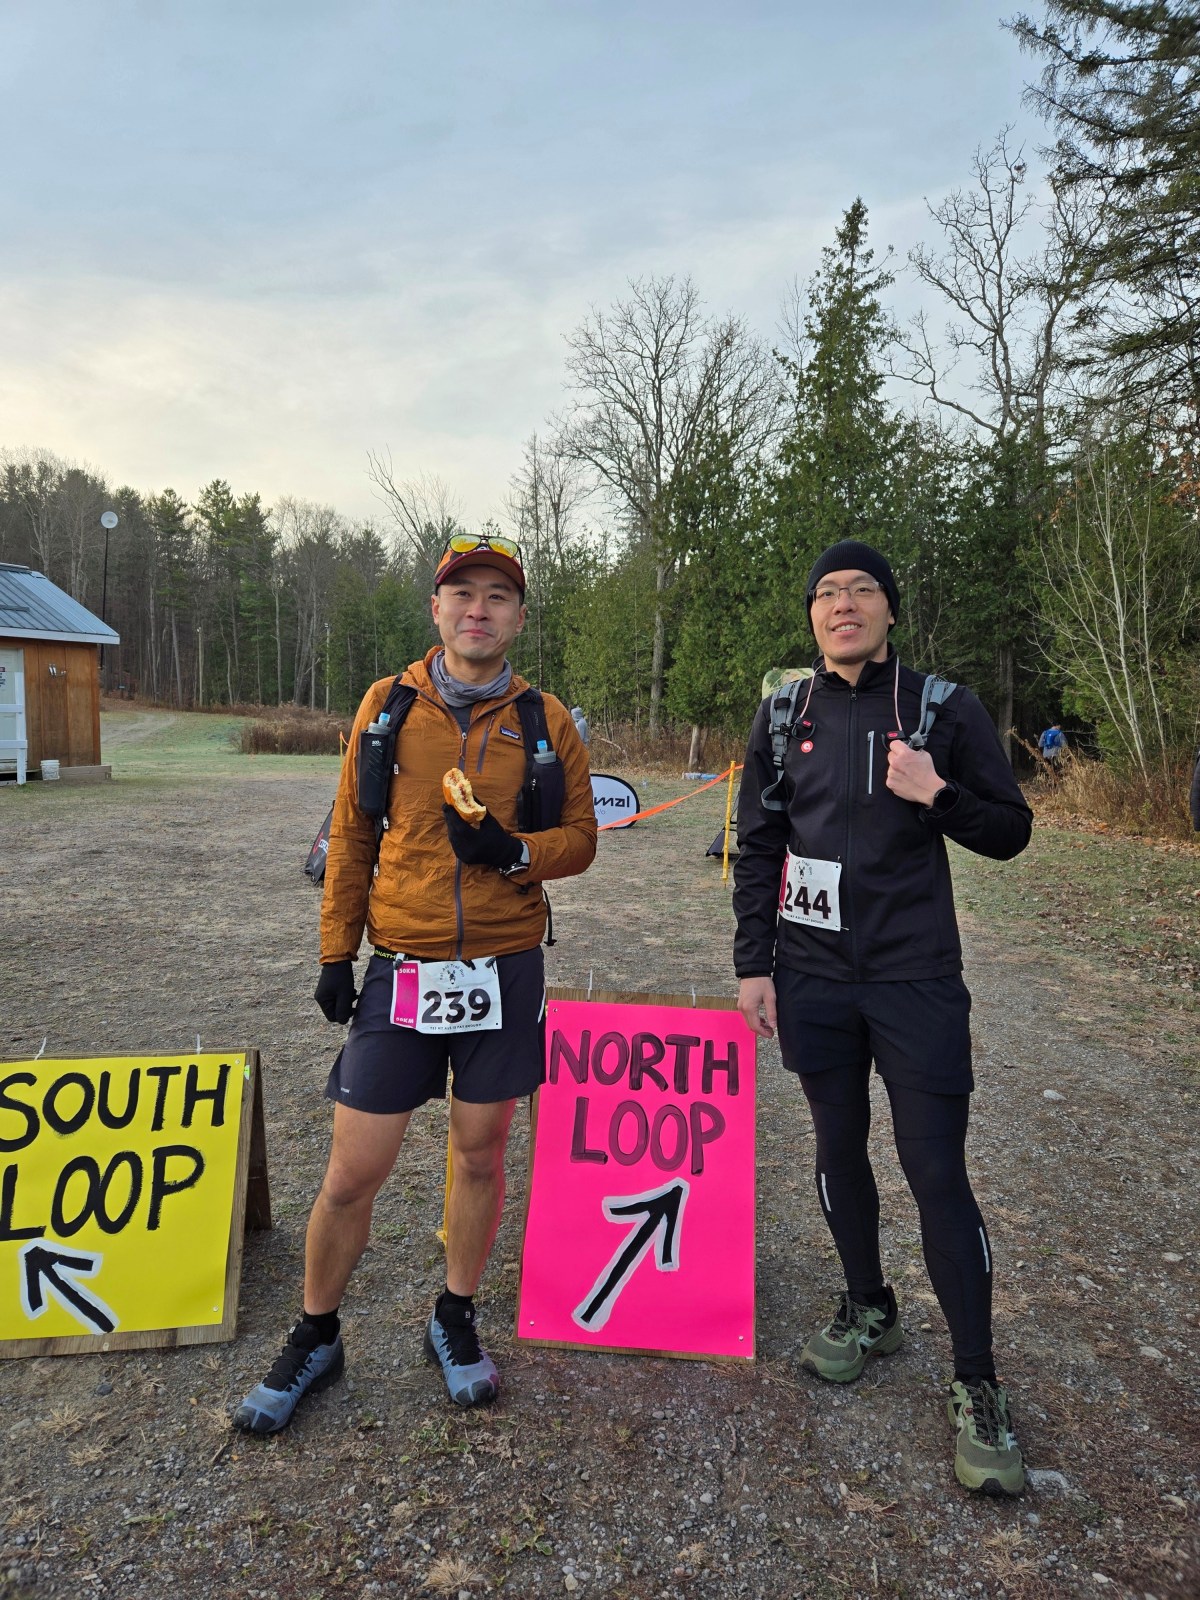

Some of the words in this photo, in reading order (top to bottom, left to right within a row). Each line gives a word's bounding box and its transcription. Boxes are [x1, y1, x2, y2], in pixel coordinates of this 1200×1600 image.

[784, 881, 832, 920] 244
[421, 988, 491, 1024] 239
[549, 1029, 740, 1096] NORTH
[0, 1064, 231, 1153] SOUTH
[570, 1096, 726, 1177] LOOP
[0, 1144, 206, 1241] LOOP
